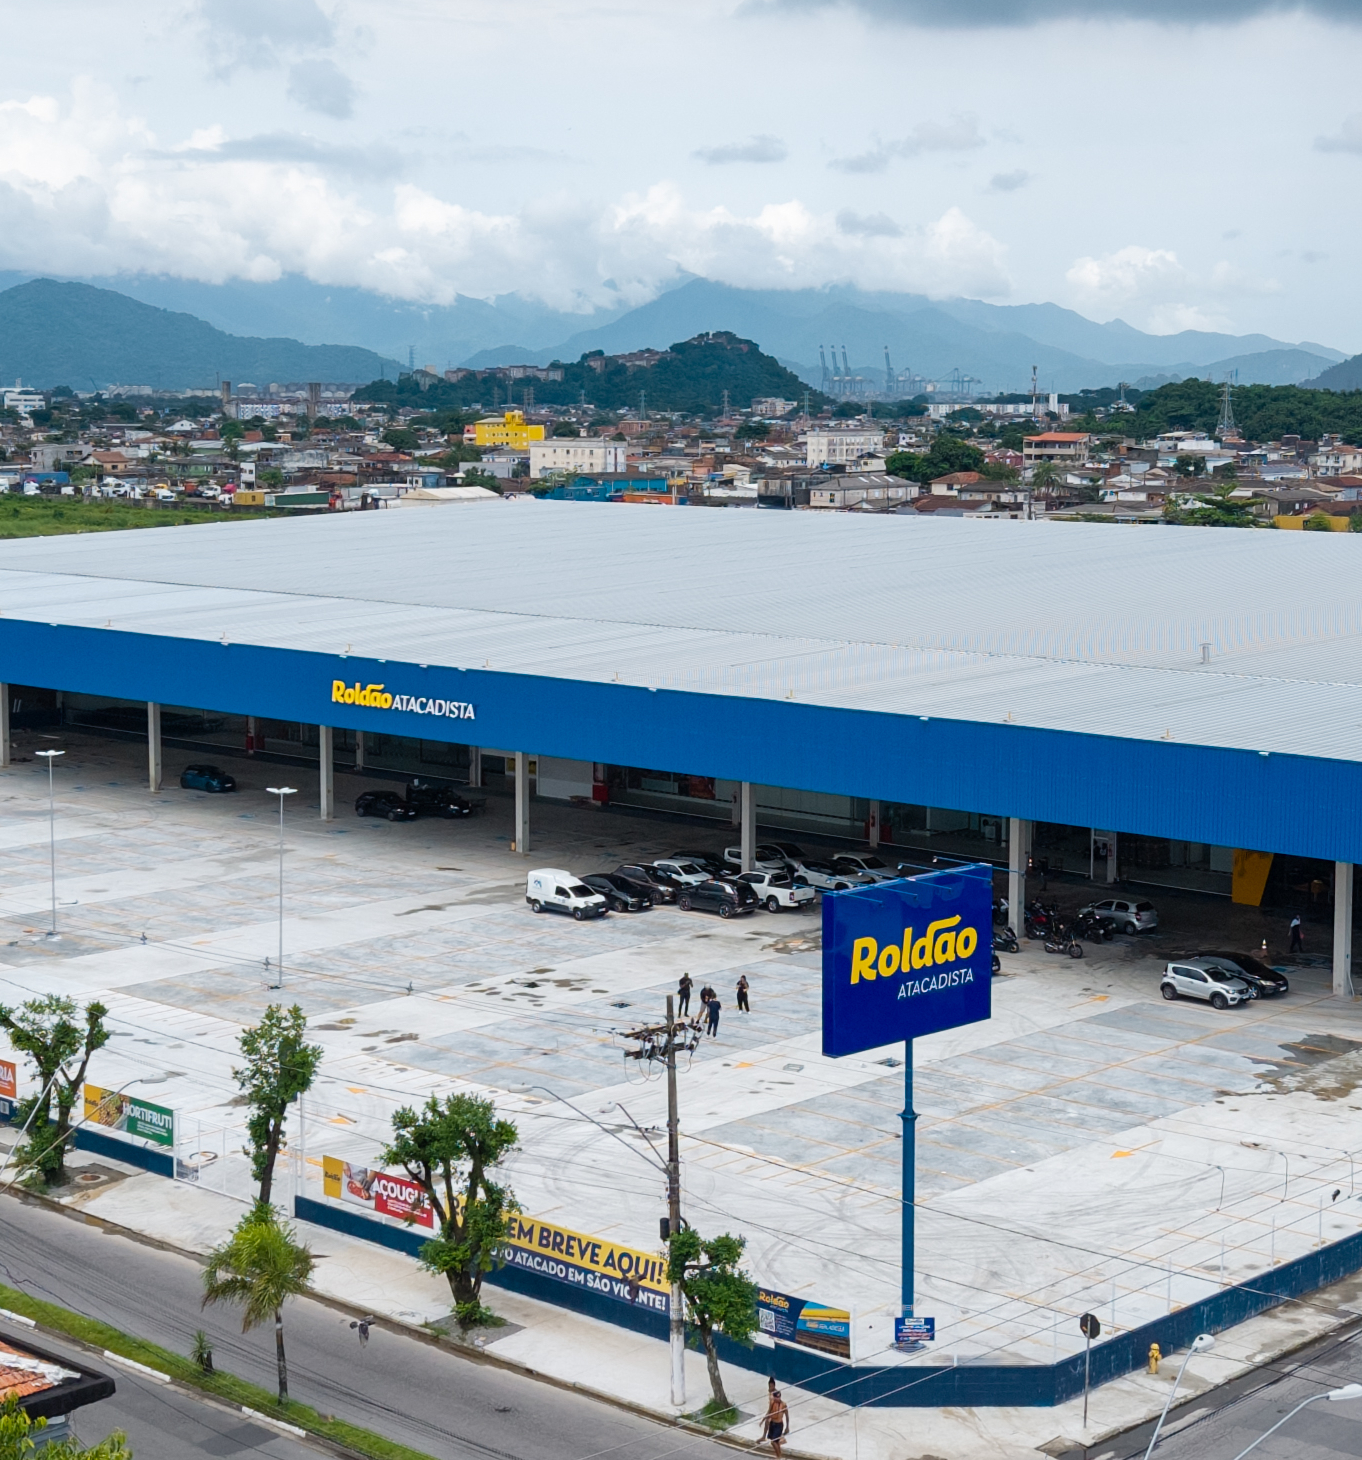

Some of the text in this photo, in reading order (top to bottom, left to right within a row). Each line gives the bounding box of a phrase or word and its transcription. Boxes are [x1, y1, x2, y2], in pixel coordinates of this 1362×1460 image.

[331, 679, 476, 720] Roldão ATACADISTA
[850, 914, 978, 985] Roldão
[897, 967, 974, 1000] ATACADISTA
[122, 1101, 172, 1130] HORTIFRUTI
[508, 1216, 664, 1285] EM BREVE AQUI!
[514, 1252, 566, 1278] ATACADO
[567, 1268, 585, 1285] EM
[586, 1271, 611, 1293] SÃO
[611, 1280, 667, 1311] VICNTE!
